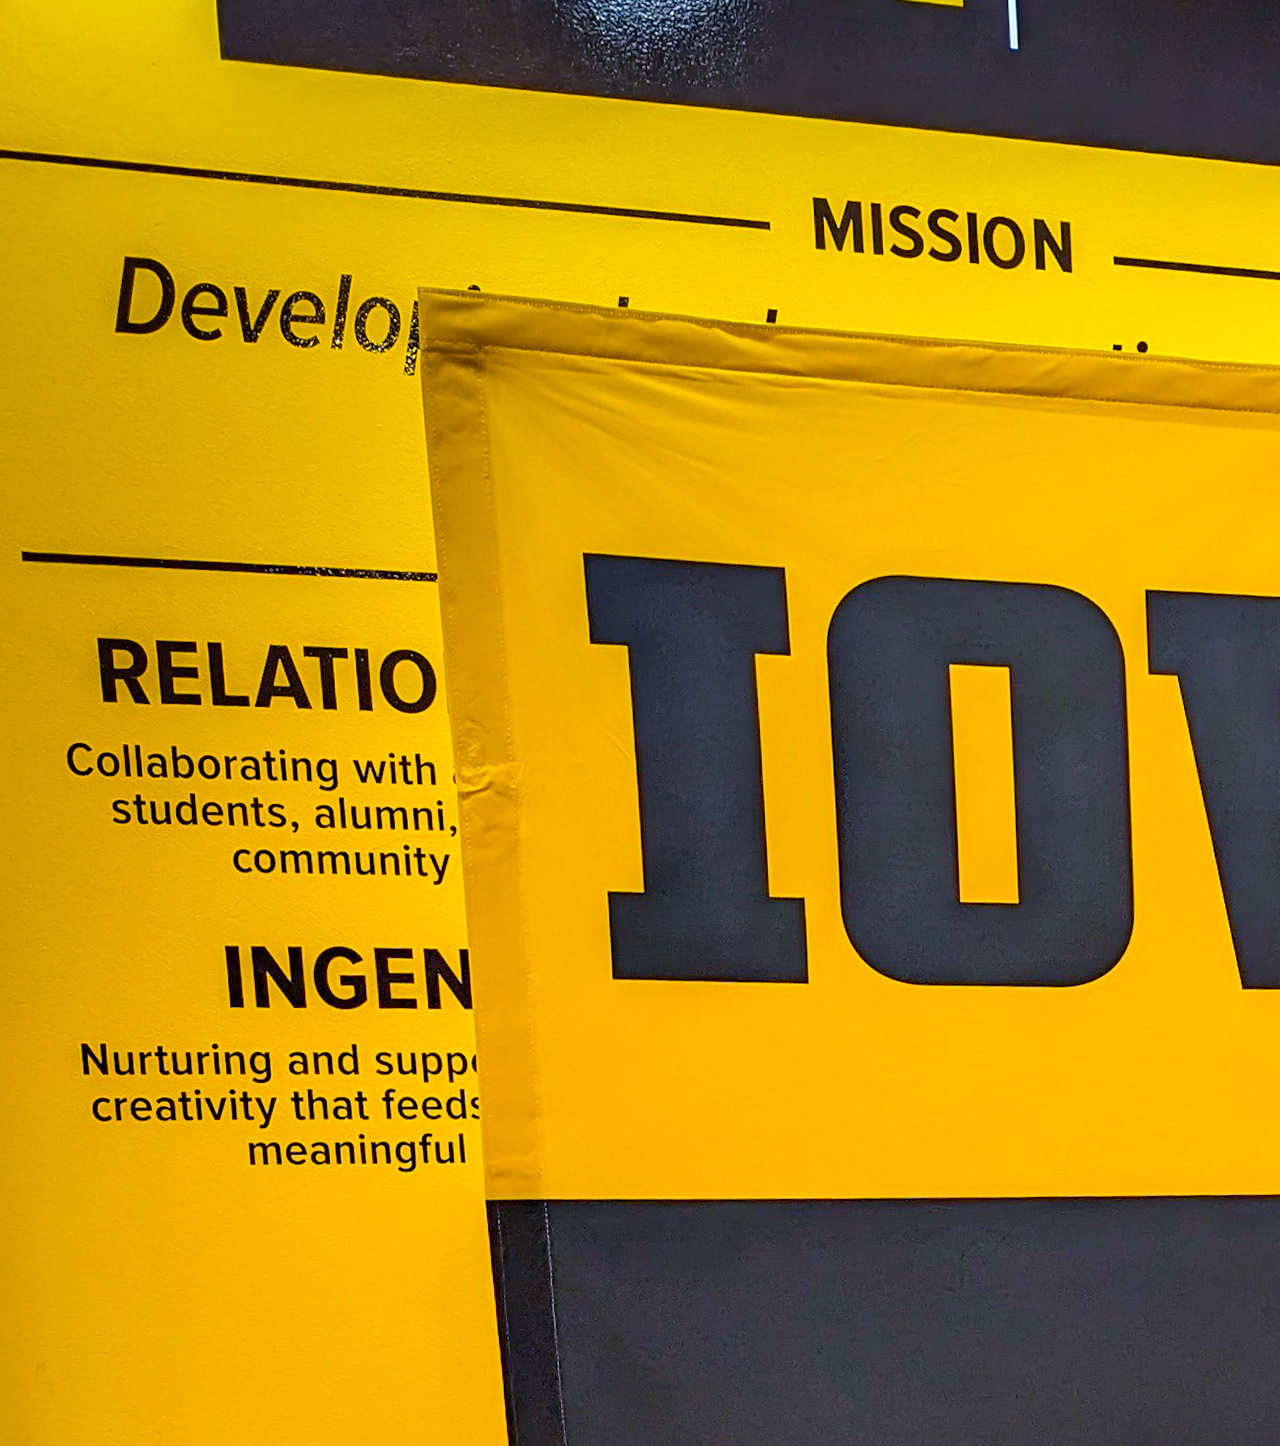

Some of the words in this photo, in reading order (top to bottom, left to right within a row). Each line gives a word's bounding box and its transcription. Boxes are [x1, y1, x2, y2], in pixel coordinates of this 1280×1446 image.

[811, 197, 1074, 273] MISSION
[66, 742, 338, 791] Collaborating
[353, 753, 437, 786] with
[112, 794, 300, 833] students,
[315, 797, 459, 836] alumni,
[232, 844, 450, 885] community
[81, 1043, 272, 1083] Nurturing
[288, 1044, 360, 1076] and
[92, 1088, 277, 1128] creativity
[291, 1089, 369, 1120] that
[249, 1133, 466, 1172] meaningful
